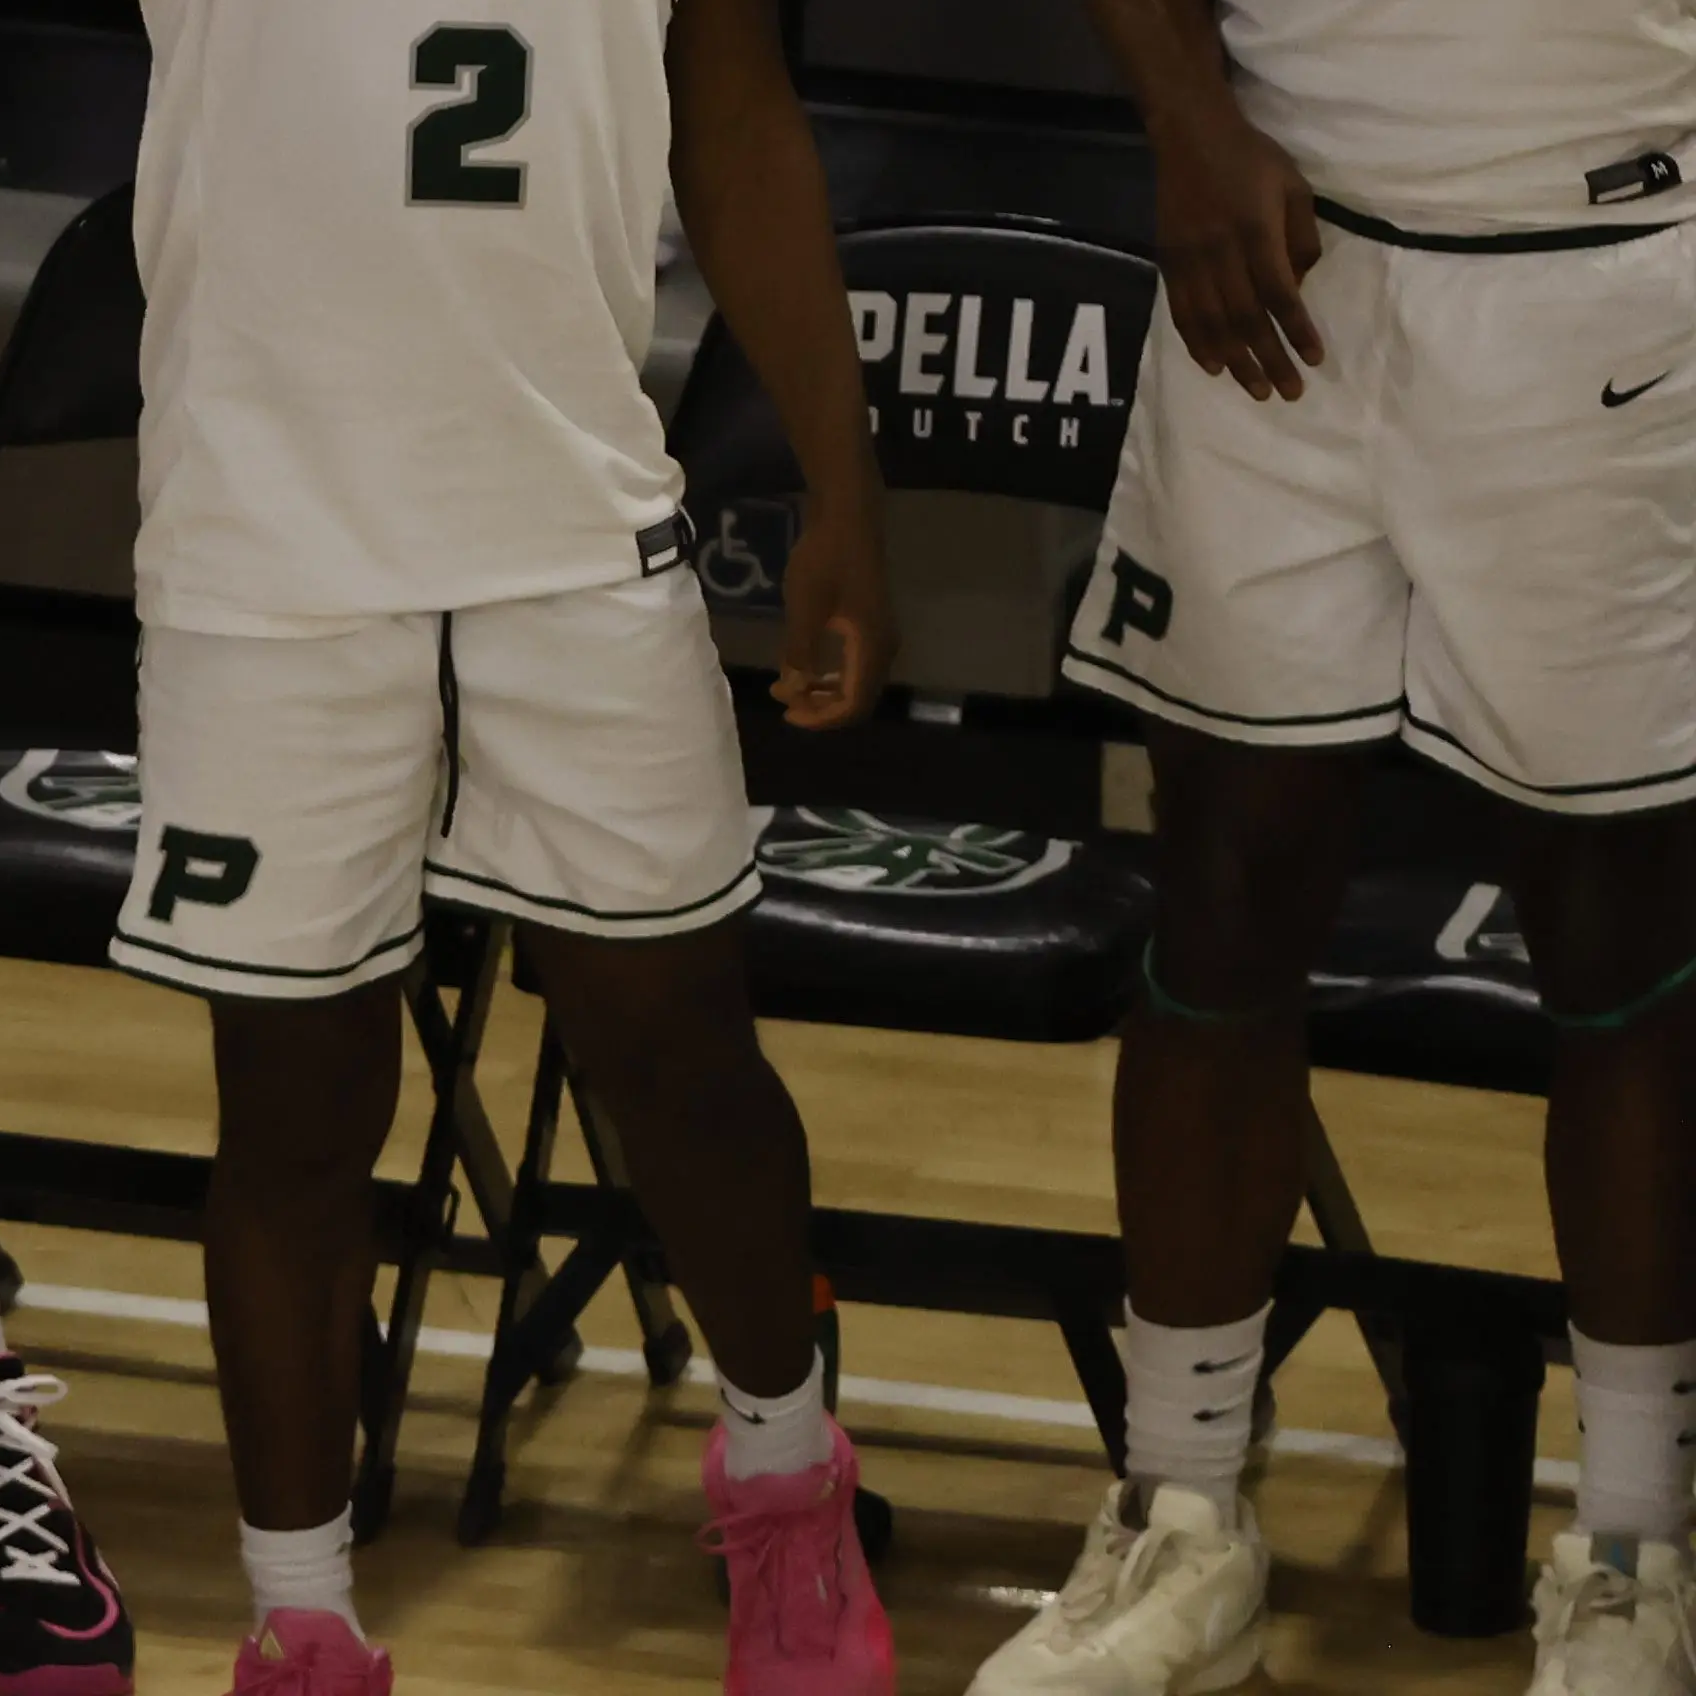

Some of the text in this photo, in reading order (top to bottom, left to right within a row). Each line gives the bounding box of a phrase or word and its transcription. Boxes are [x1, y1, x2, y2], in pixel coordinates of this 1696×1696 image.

[407, 22, 532, 208] 2
[1102, 551, 1174, 646] P
[148, 824, 260, 924] P
